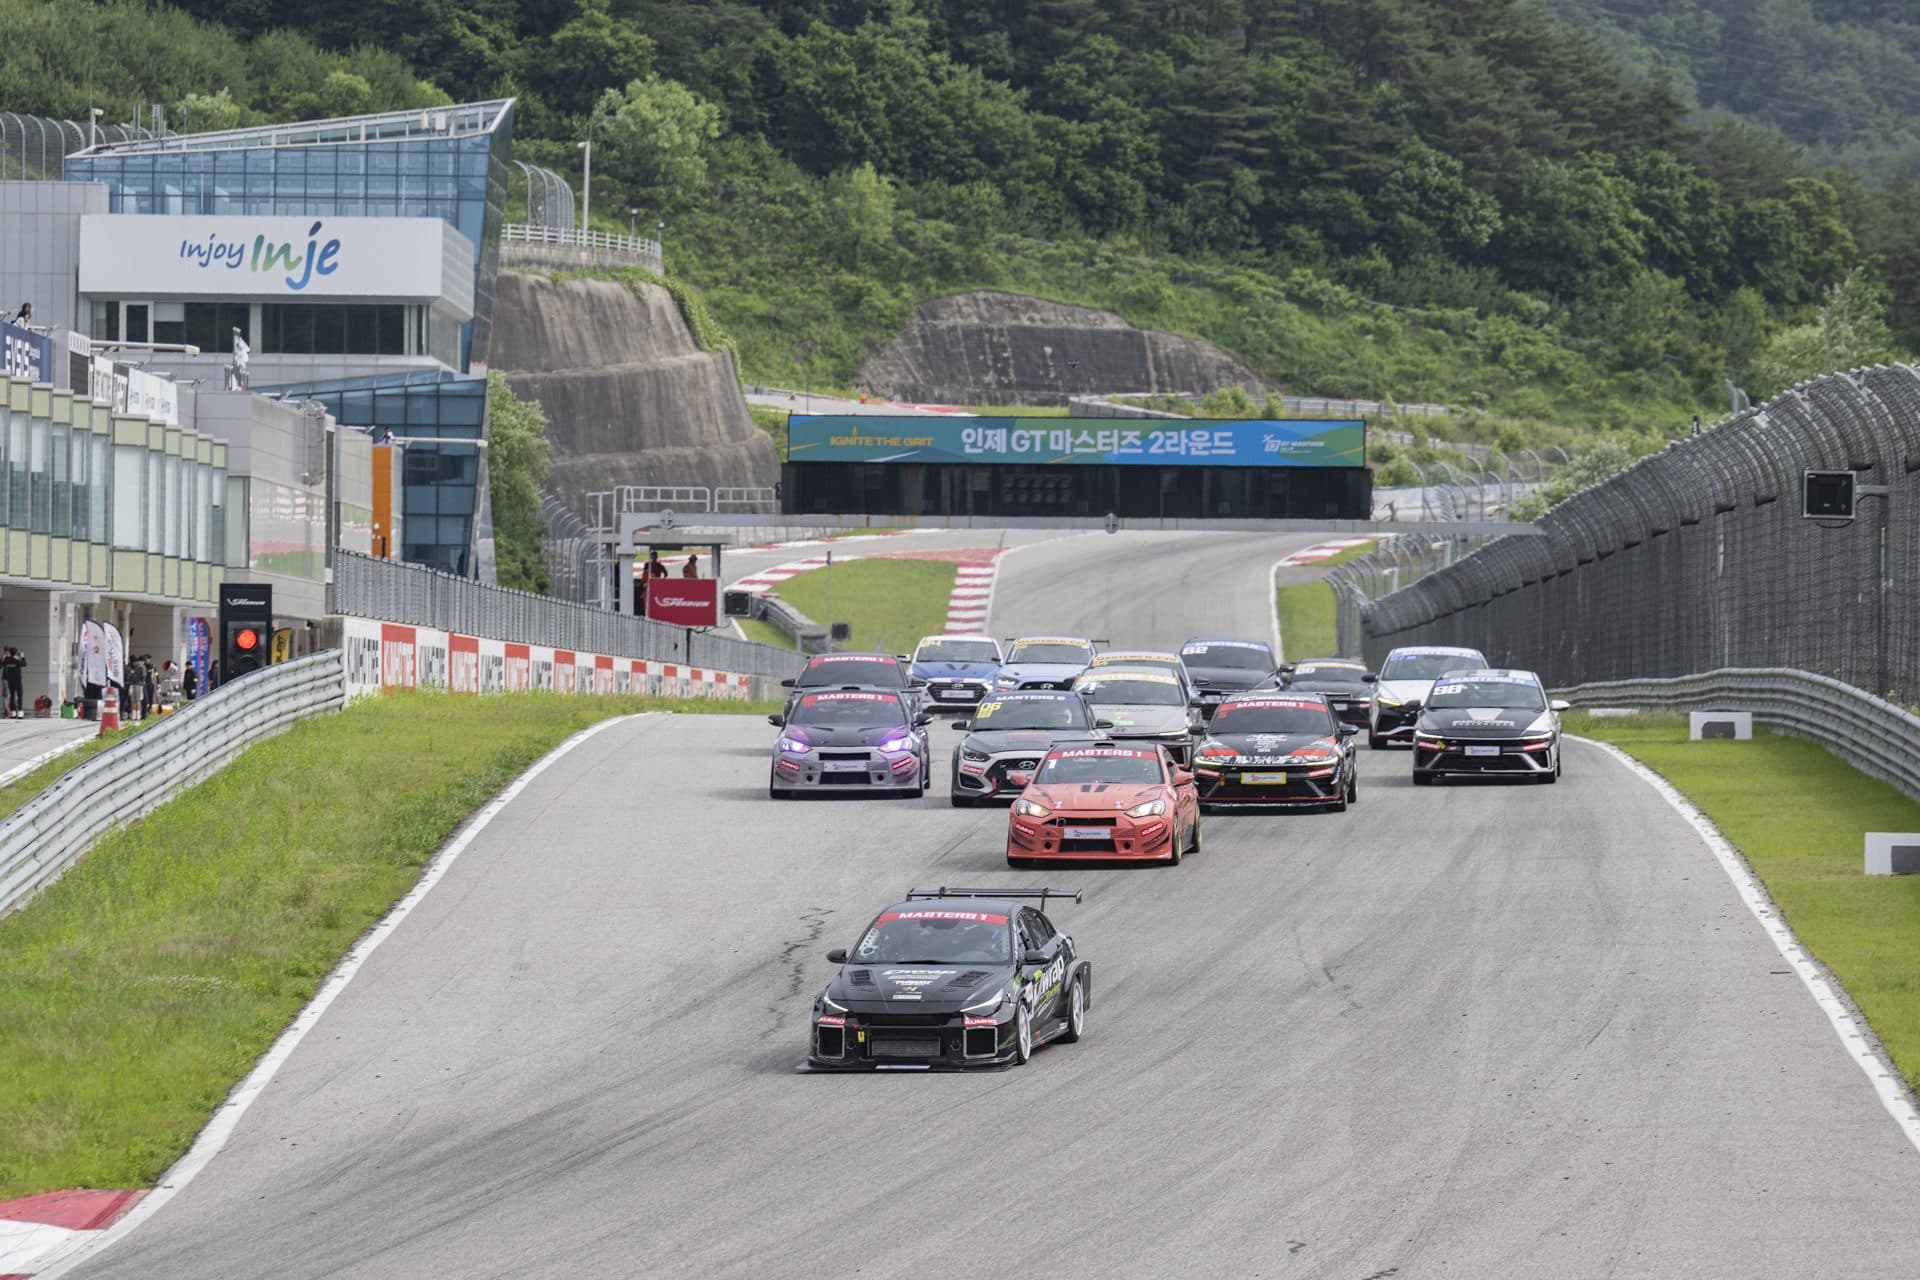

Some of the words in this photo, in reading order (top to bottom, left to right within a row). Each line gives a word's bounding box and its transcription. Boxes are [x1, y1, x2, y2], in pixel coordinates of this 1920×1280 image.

[180, 233, 245, 268] Injoy
[250, 221, 341, 290] Inje
[830, 432, 873, 447] IGNITE
[877, 436, 901, 447] THE
[904, 436, 934, 447] GRIT
[961, 428, 1008, 455] 인제
[1011, 430, 1046, 454] GT
[1050, 429, 1143, 455] 마스터즈
[1149, 430, 1236, 457] 2라운드
[817, 693, 875, 701] MASTERS
[1237, 701, 1297, 709] MASTERS
[1062, 748, 1133, 757] MASTERS
[898, 911, 977, 920] MASTERS
